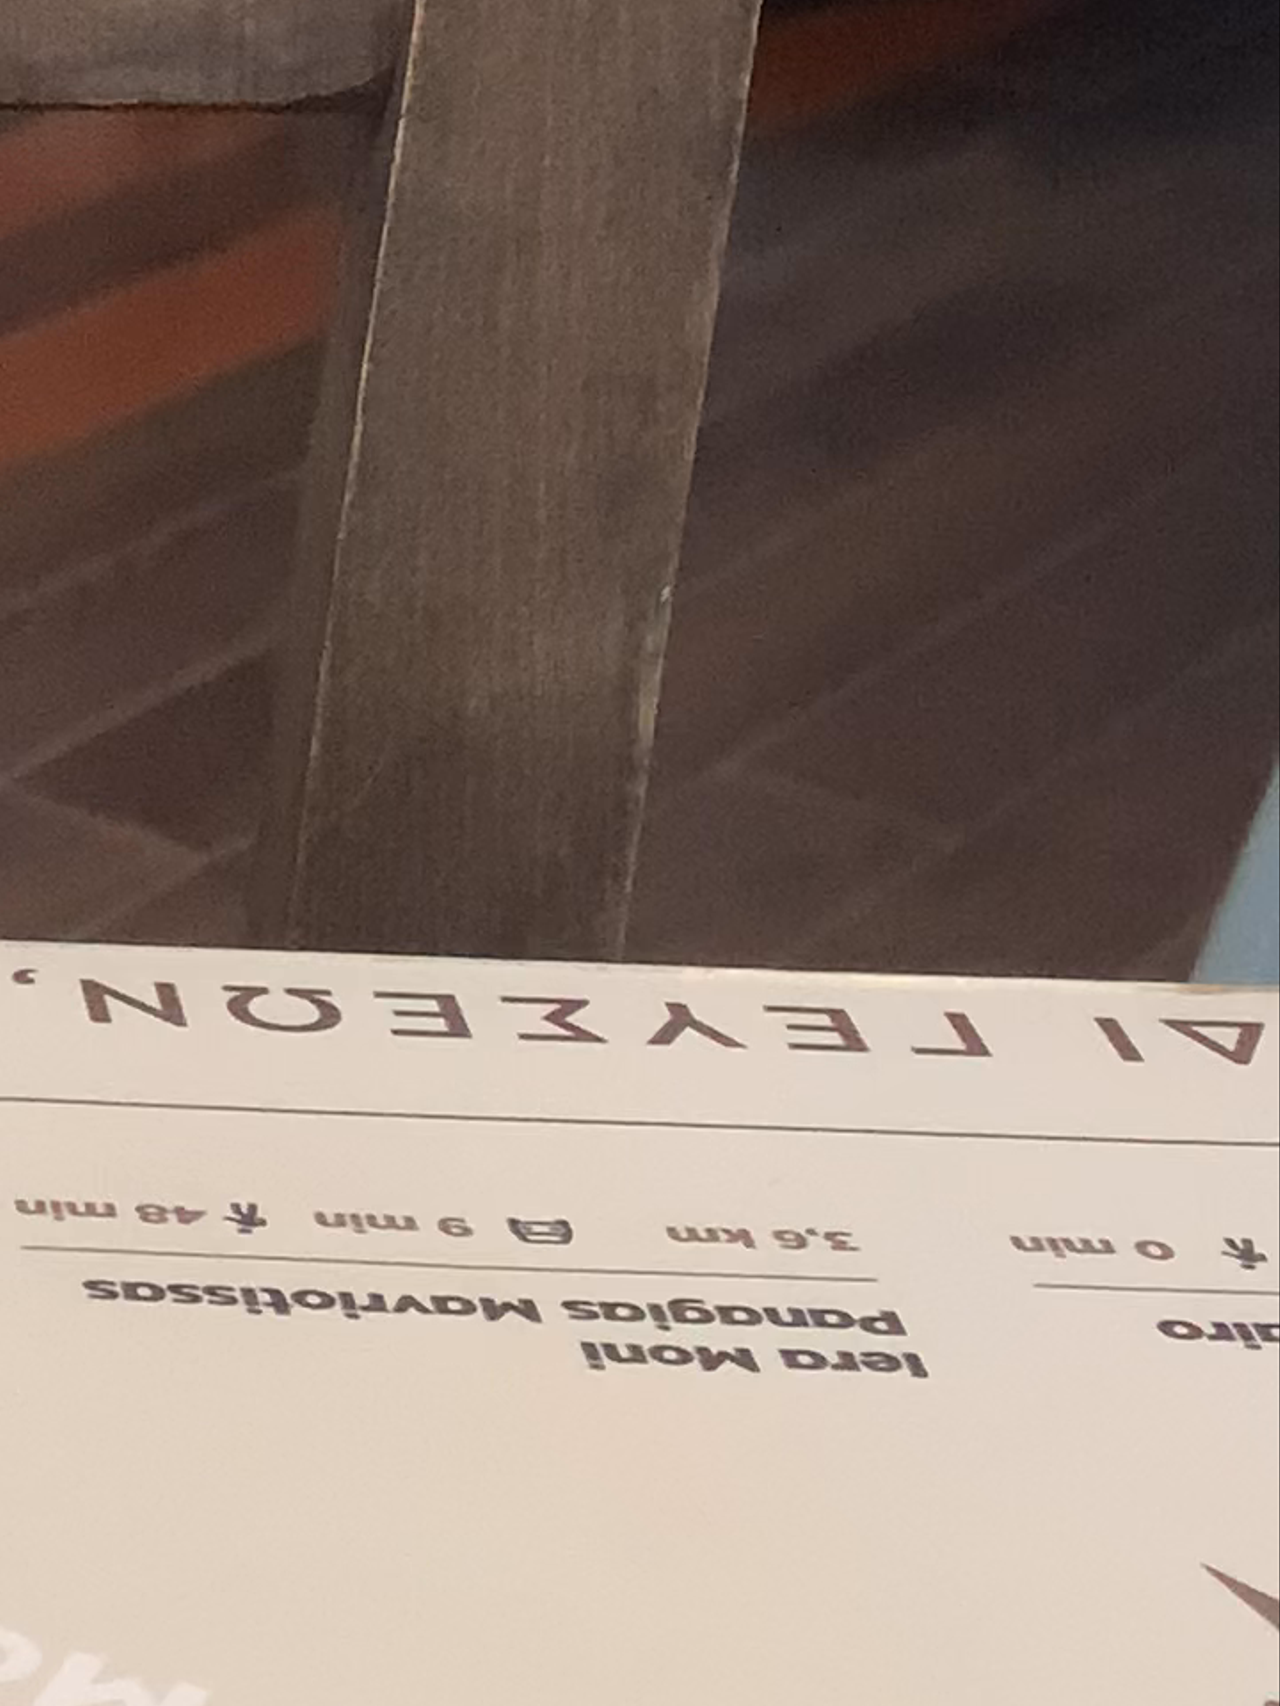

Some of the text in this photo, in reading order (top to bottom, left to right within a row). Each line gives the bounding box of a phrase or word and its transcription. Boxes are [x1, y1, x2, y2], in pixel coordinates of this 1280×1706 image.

[10, 968, 994, 1059] ΓΕΥΣΕΩΝ,
[13, 1198, 119, 1223] min
[134, 1202, 208, 1226] 48
[312, 1210, 421, 1235] min
[436, 1216, 475, 1238] 9
[665, 1225, 758, 1250] km
[1008, 1234, 1176, 1262] 0 min
[80, 1277, 909, 1338] Panagias Mavriotissas
[578, 1339, 931, 1381] Iera Moni
